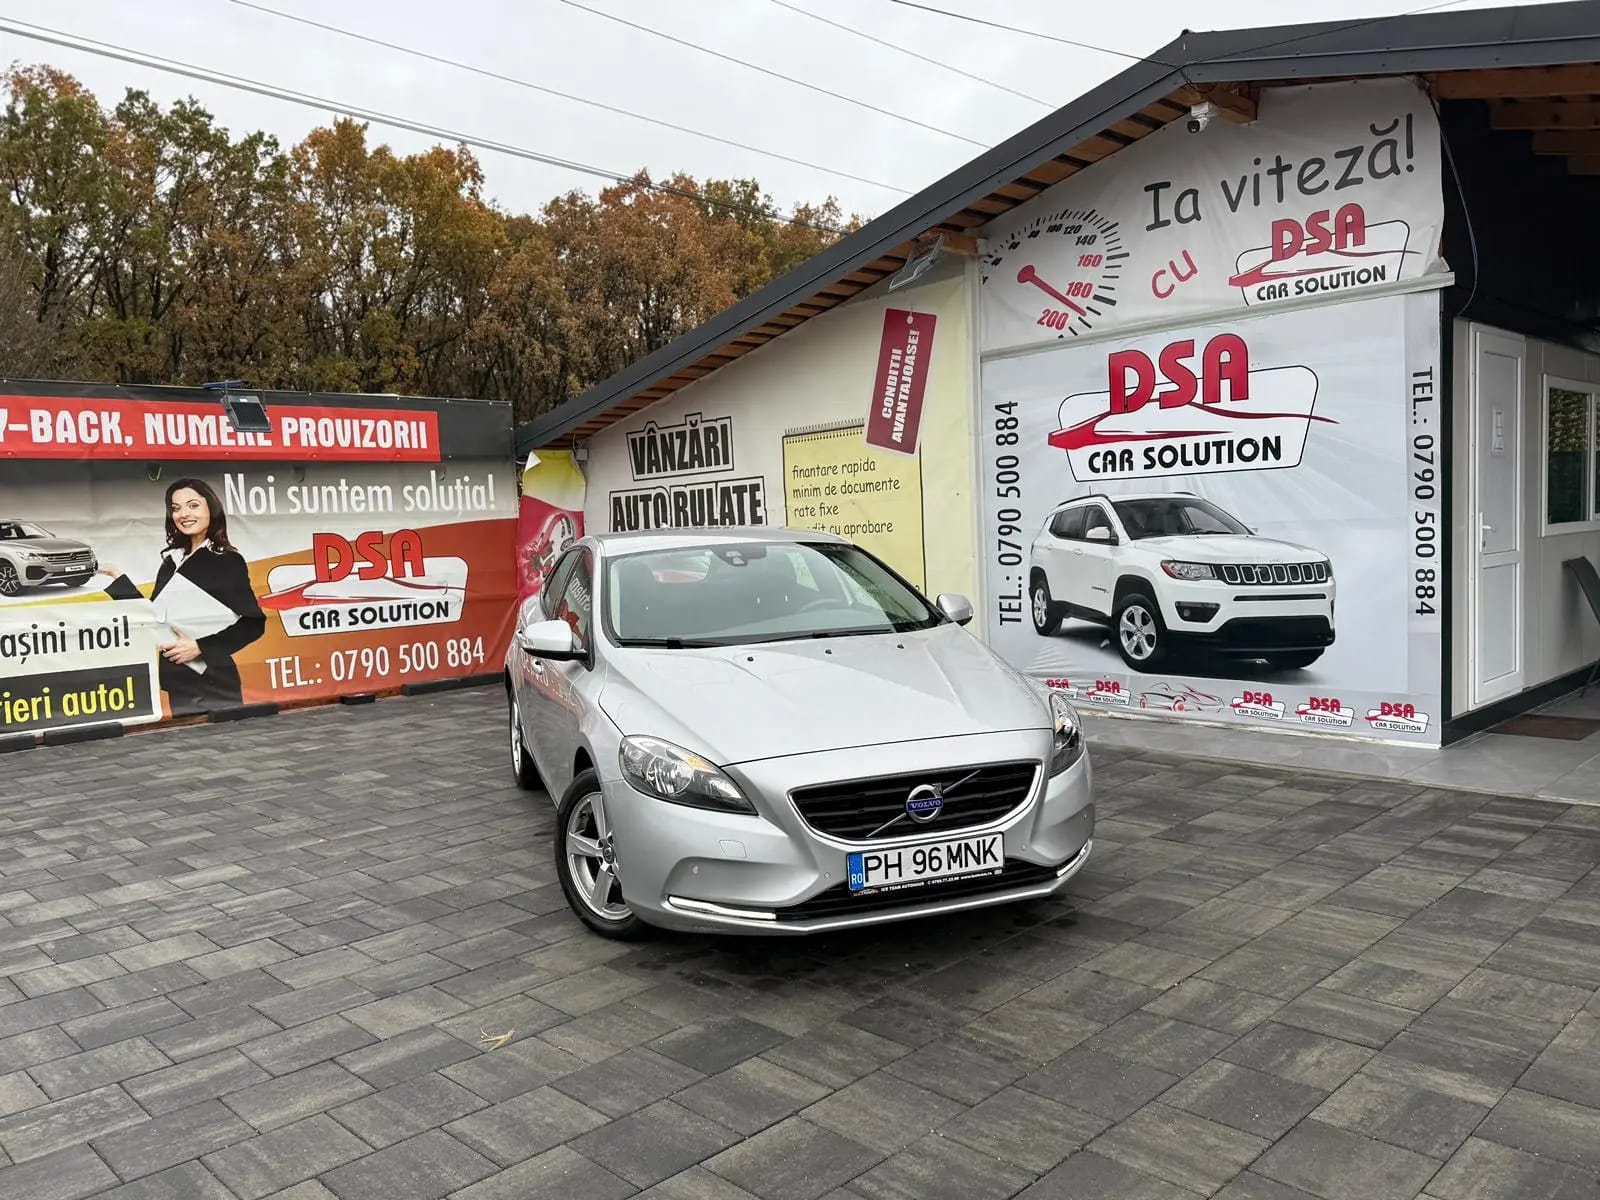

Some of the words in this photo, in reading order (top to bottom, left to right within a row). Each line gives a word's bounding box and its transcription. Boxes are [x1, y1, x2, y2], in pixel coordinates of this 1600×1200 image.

[1144, 181, 1201, 232] Ia
[1221, 112, 1414, 213] viteză!
[1063, 225, 1082, 235] 120
[1075, 234, 1098, 246] 140
[1271, 203, 1366, 262] DSA
[1077, 254, 1103, 268] 160
[1151, 249, 1198, 299] cu
[1065, 281, 1094, 298] 180
[1256, 278, 1289, 301] CAR
[1294, 265, 1386, 298] SOLUTION
[1037, 309, 1069, 331] 200
[881, 348, 902, 419] CONDITII
[891, 329, 920, 443] AVANTAJOASE!
[1109, 333, 1249, 415] DSA
[1412, 366, 1433, 425] TEL.:
[281, 417, 428, 449] PROVIZORII
[995, 401, 1019, 446] 884
[630, 419, 731, 475] VÂNZĂRI
[1088, 450, 1134, 473] CAR
[1143, 435, 1282, 470] SOLUTION
[792, 464, 838, 481] finantare
[841, 457, 876, 478] rapida
[996, 455, 1021, 499] 500
[1413, 434, 1435, 500] 0790
[224, 473, 276, 515] Noi
[287, 478, 394, 514] suntem
[792, 483, 821, 499] minim
[824, 484, 837, 496] de
[840, 477, 900, 496] documente
[794, 504, 816, 518] rate
[819, 502, 839, 517] fixe
[843, 520, 894, 538] aprobare
[998, 508, 1022, 566] 0790
[1415, 511, 1436, 558] 500
[313, 529, 425, 583] DSA
[999, 575, 1022, 626] TEL.:
[1415, 568, 1436, 616] 884
[79, 615, 130, 651] noi!
[299, 609, 340, 630] CAR
[348, 601, 449, 626] SOLUTION
[265, 656, 323, 689] TEL.:
[330, 646, 389, 681] 0790
[399, 640, 439, 673] 500
[447, 636, 485, 668] 884
[62, 676, 135, 717] auto!
[1046, 679, 1069, 689] DSA
[1095, 680, 1120, 693] DSA
[1243, 691, 1272, 706] DSA
[1250, 709, 1279, 719] SOLUTION
[1309, 697, 1341, 713] DSA
[1317, 716, 1347, 726] SOLUTION
[1380, 702, 1415, 718] DSA
[1389, 722, 1421, 732] SOLUTION
[910, 800, 941, 809] VOLVO
[864, 852, 903, 882] PH
[912, 847, 942, 875] 96
[946, 837, 999, 870] MNK
[851, 873, 863, 885] RO
